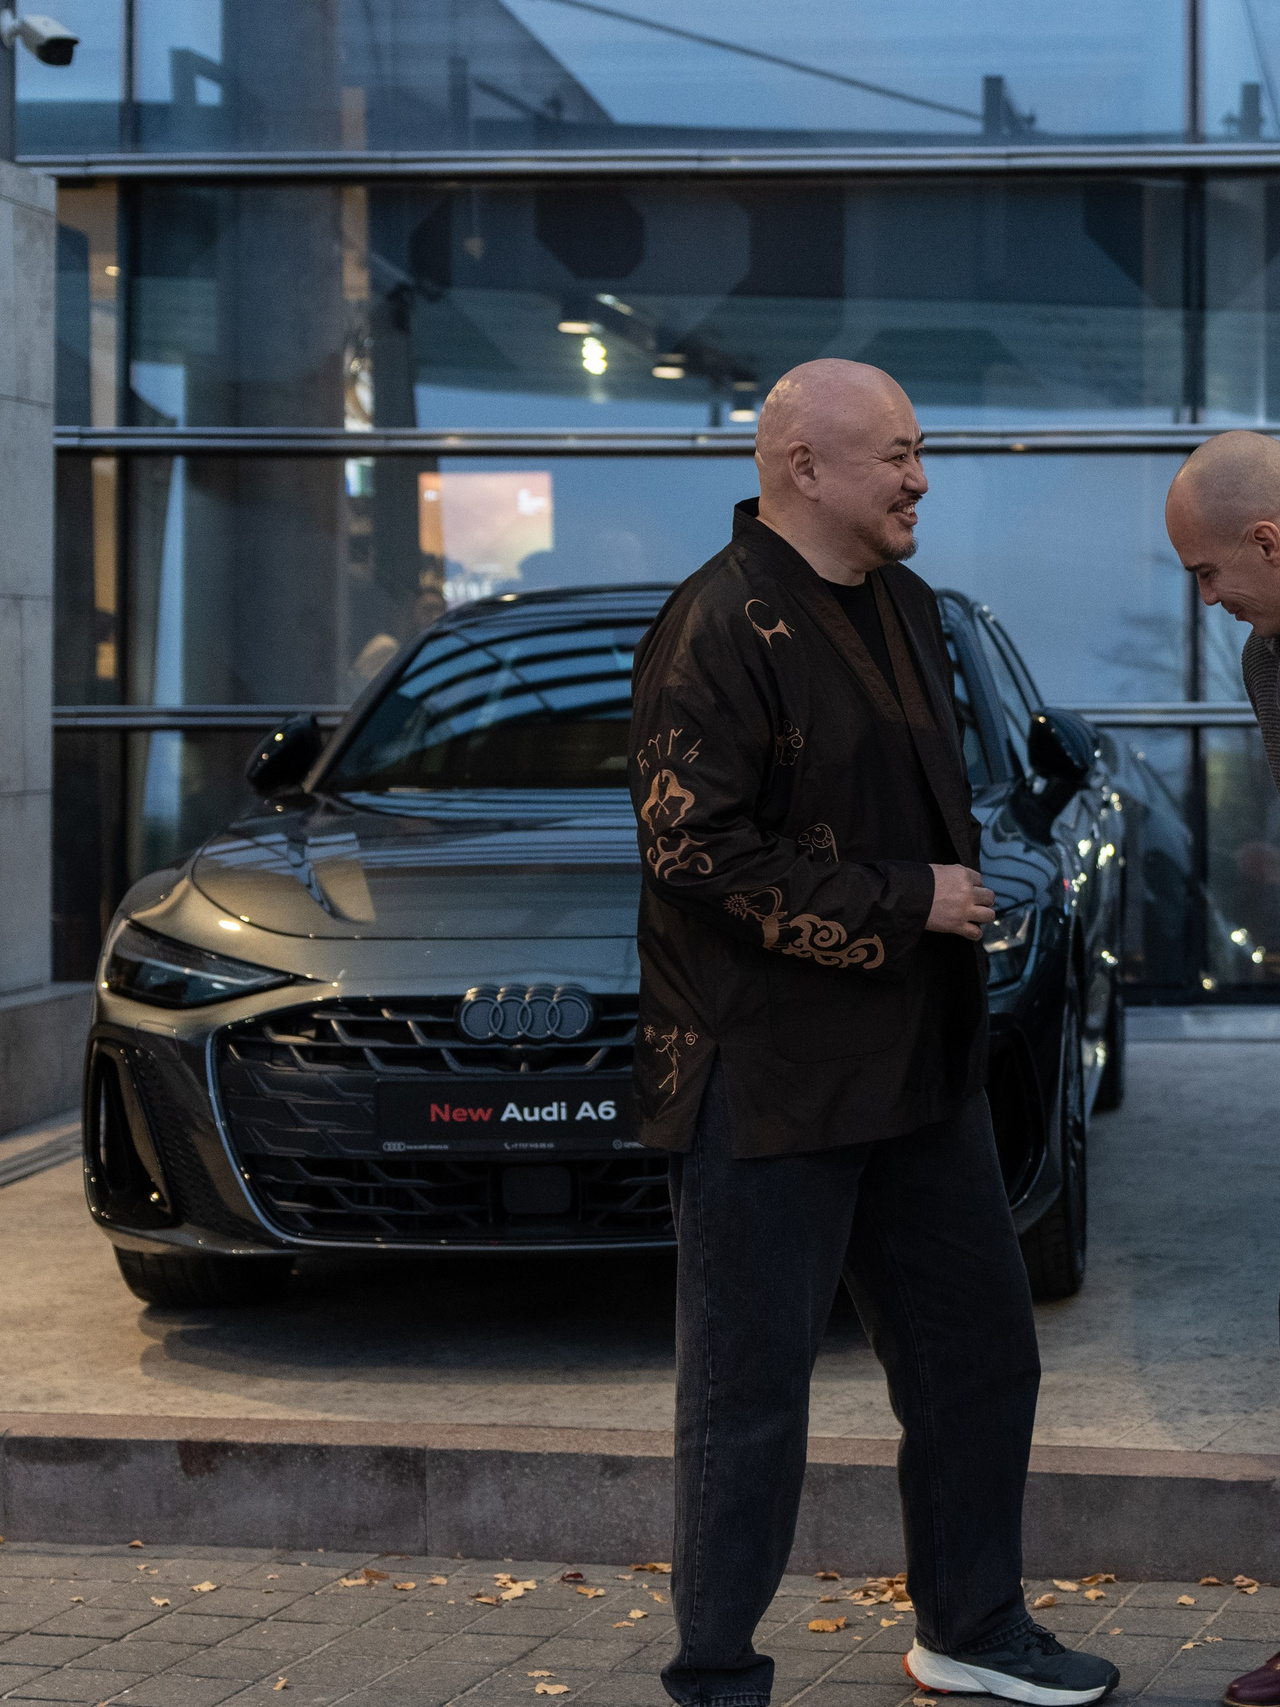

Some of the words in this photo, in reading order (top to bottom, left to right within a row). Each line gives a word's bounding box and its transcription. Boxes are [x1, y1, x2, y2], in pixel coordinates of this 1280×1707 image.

[430, 1103, 493, 1122] New
[500, 1101, 567, 1122] Audi
[575, 1101, 617, 1121] A6
